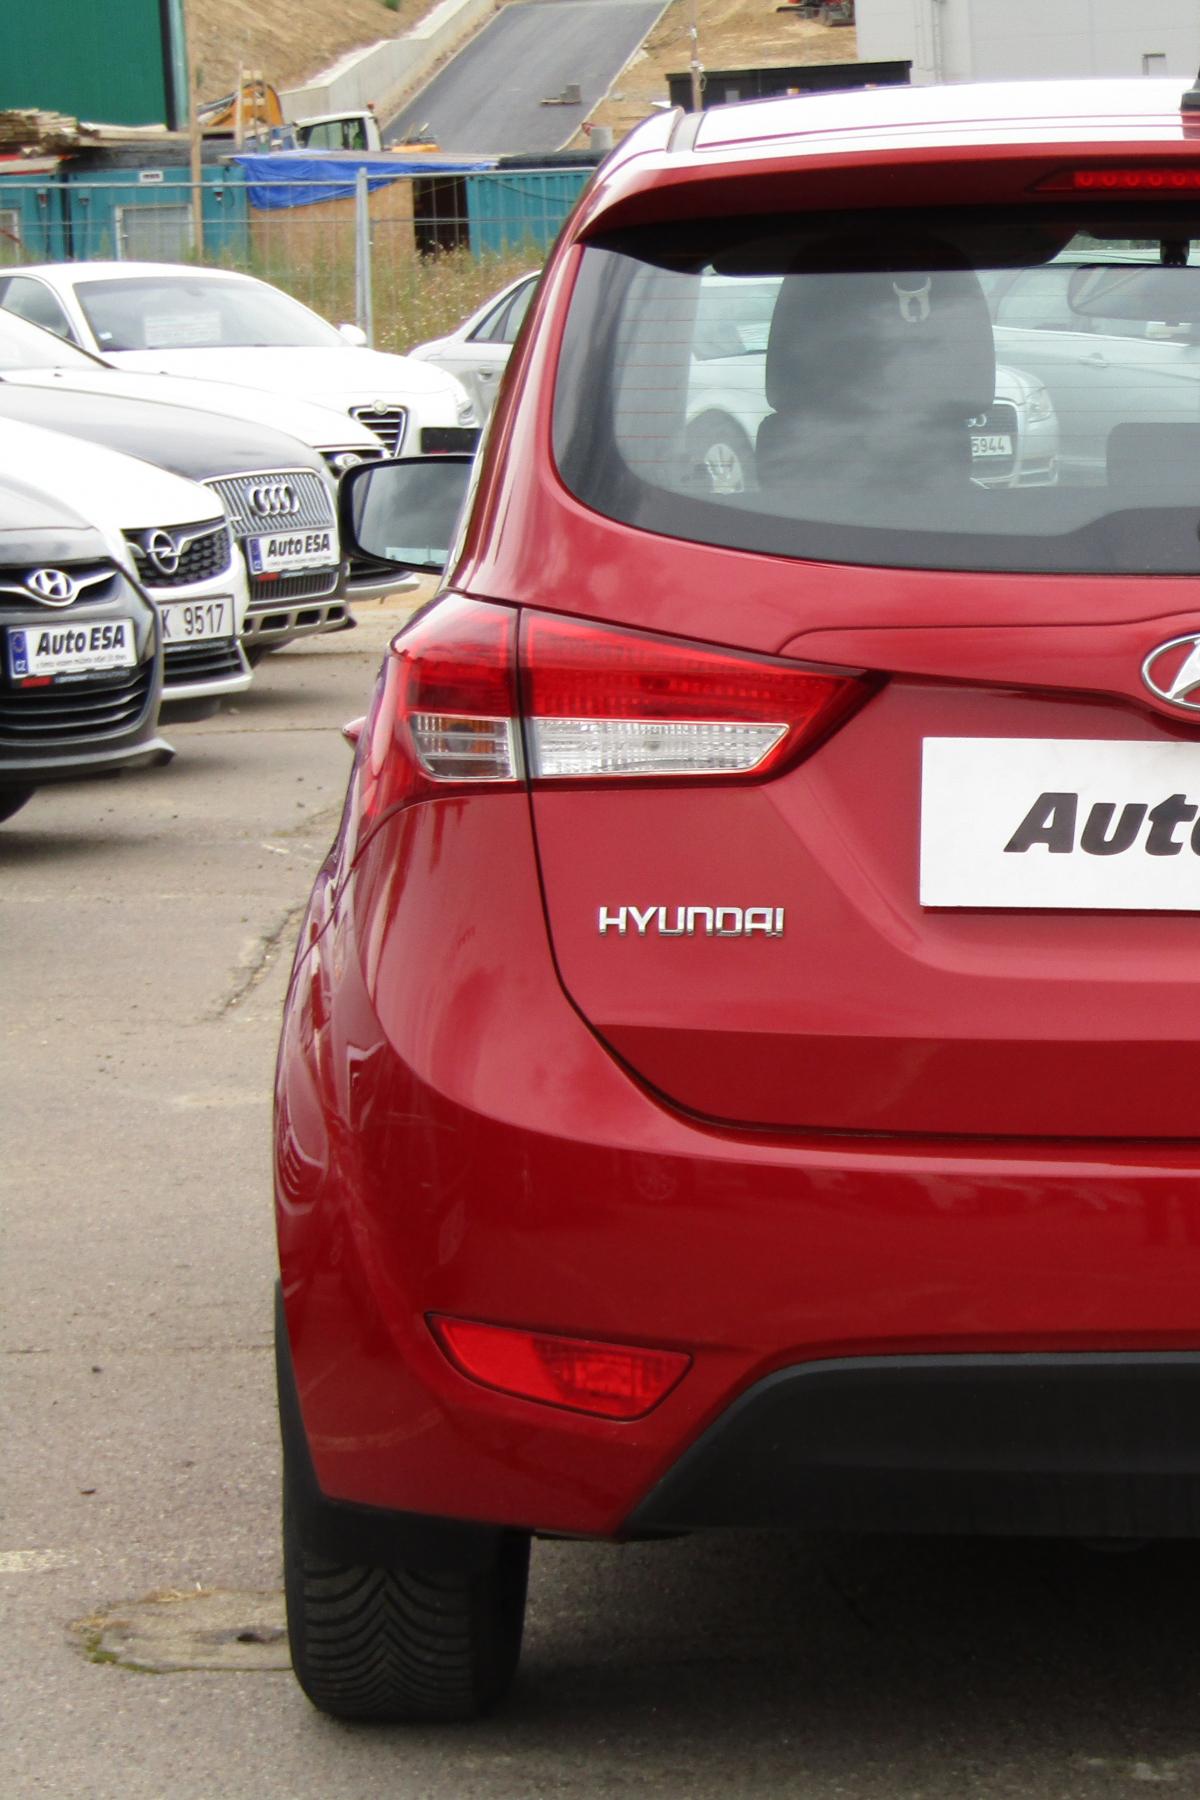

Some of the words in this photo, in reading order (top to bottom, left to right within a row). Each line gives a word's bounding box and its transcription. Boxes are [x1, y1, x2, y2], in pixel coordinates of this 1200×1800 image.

[268, 538, 303, 557] Auto
[305, 533, 331, 553] ESA
[184, 603, 224, 636] 9517
[36, 630, 86, 656] Auto
[89, 625, 125, 651] ESA
[599, 906, 786, 936] HYUNDAI
